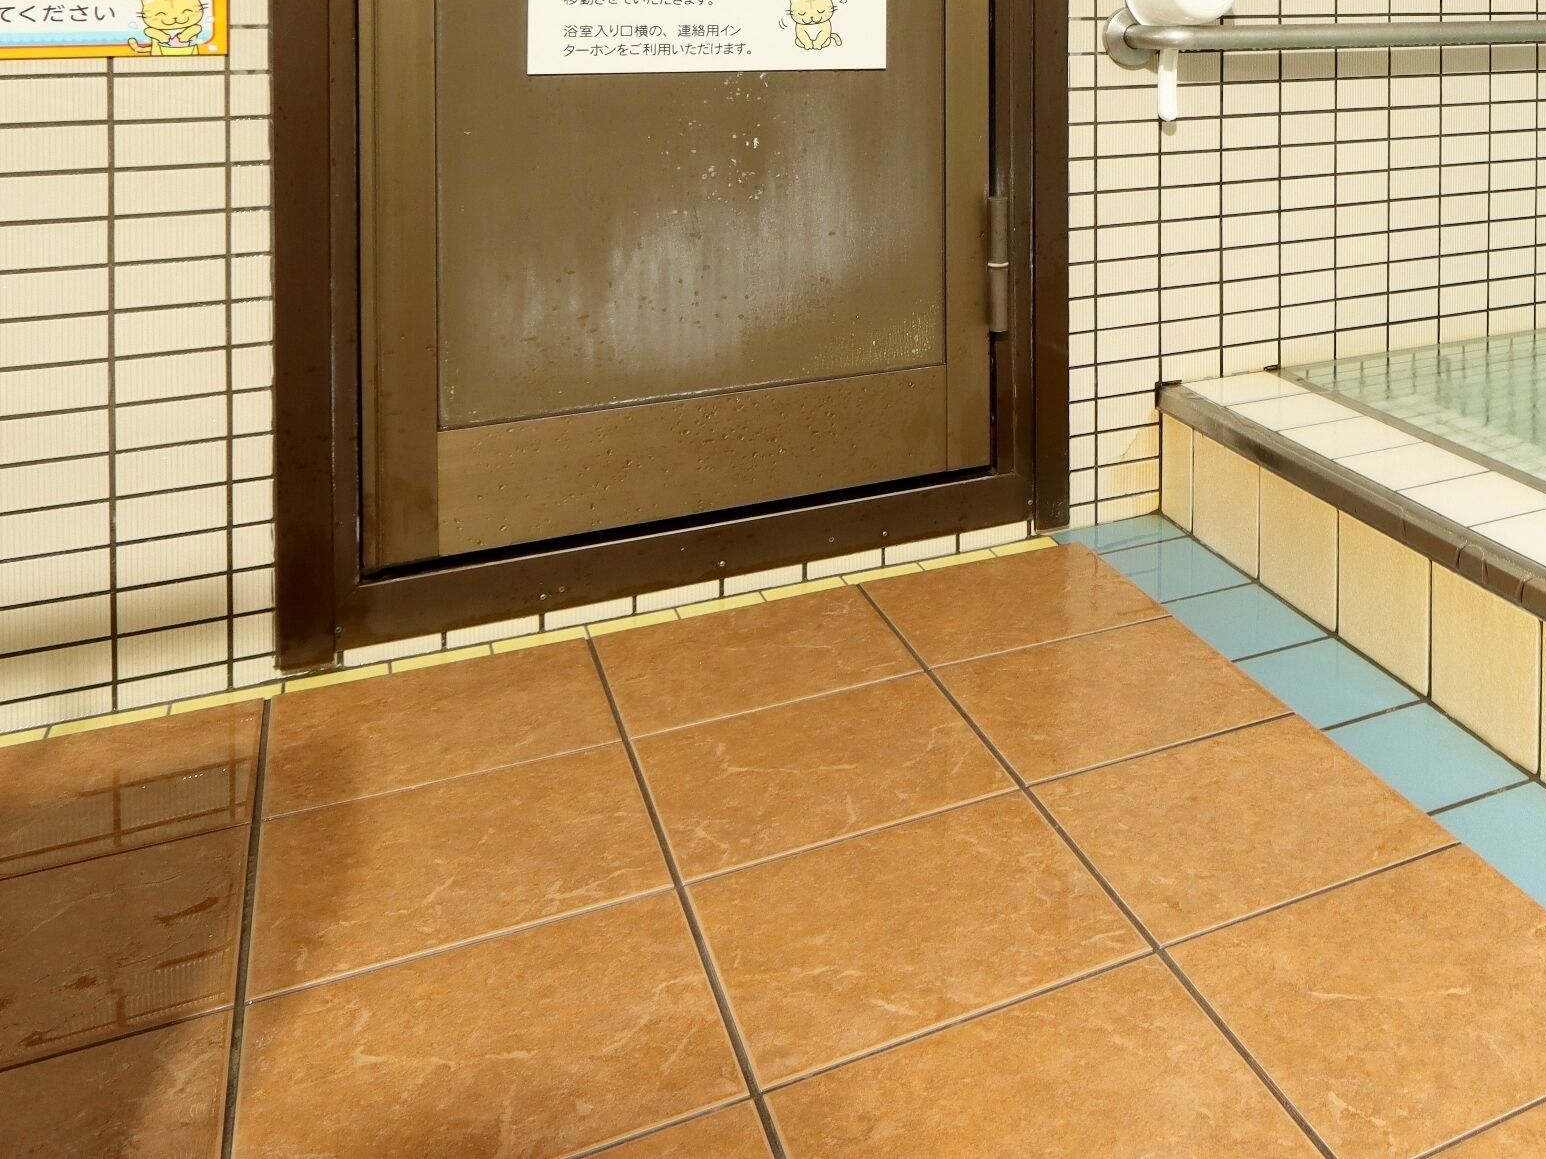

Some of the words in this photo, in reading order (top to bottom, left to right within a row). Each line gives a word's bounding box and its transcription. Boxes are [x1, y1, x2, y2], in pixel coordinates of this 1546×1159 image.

[563, 43, 752, 56] ターホンをご利用いただけます。
